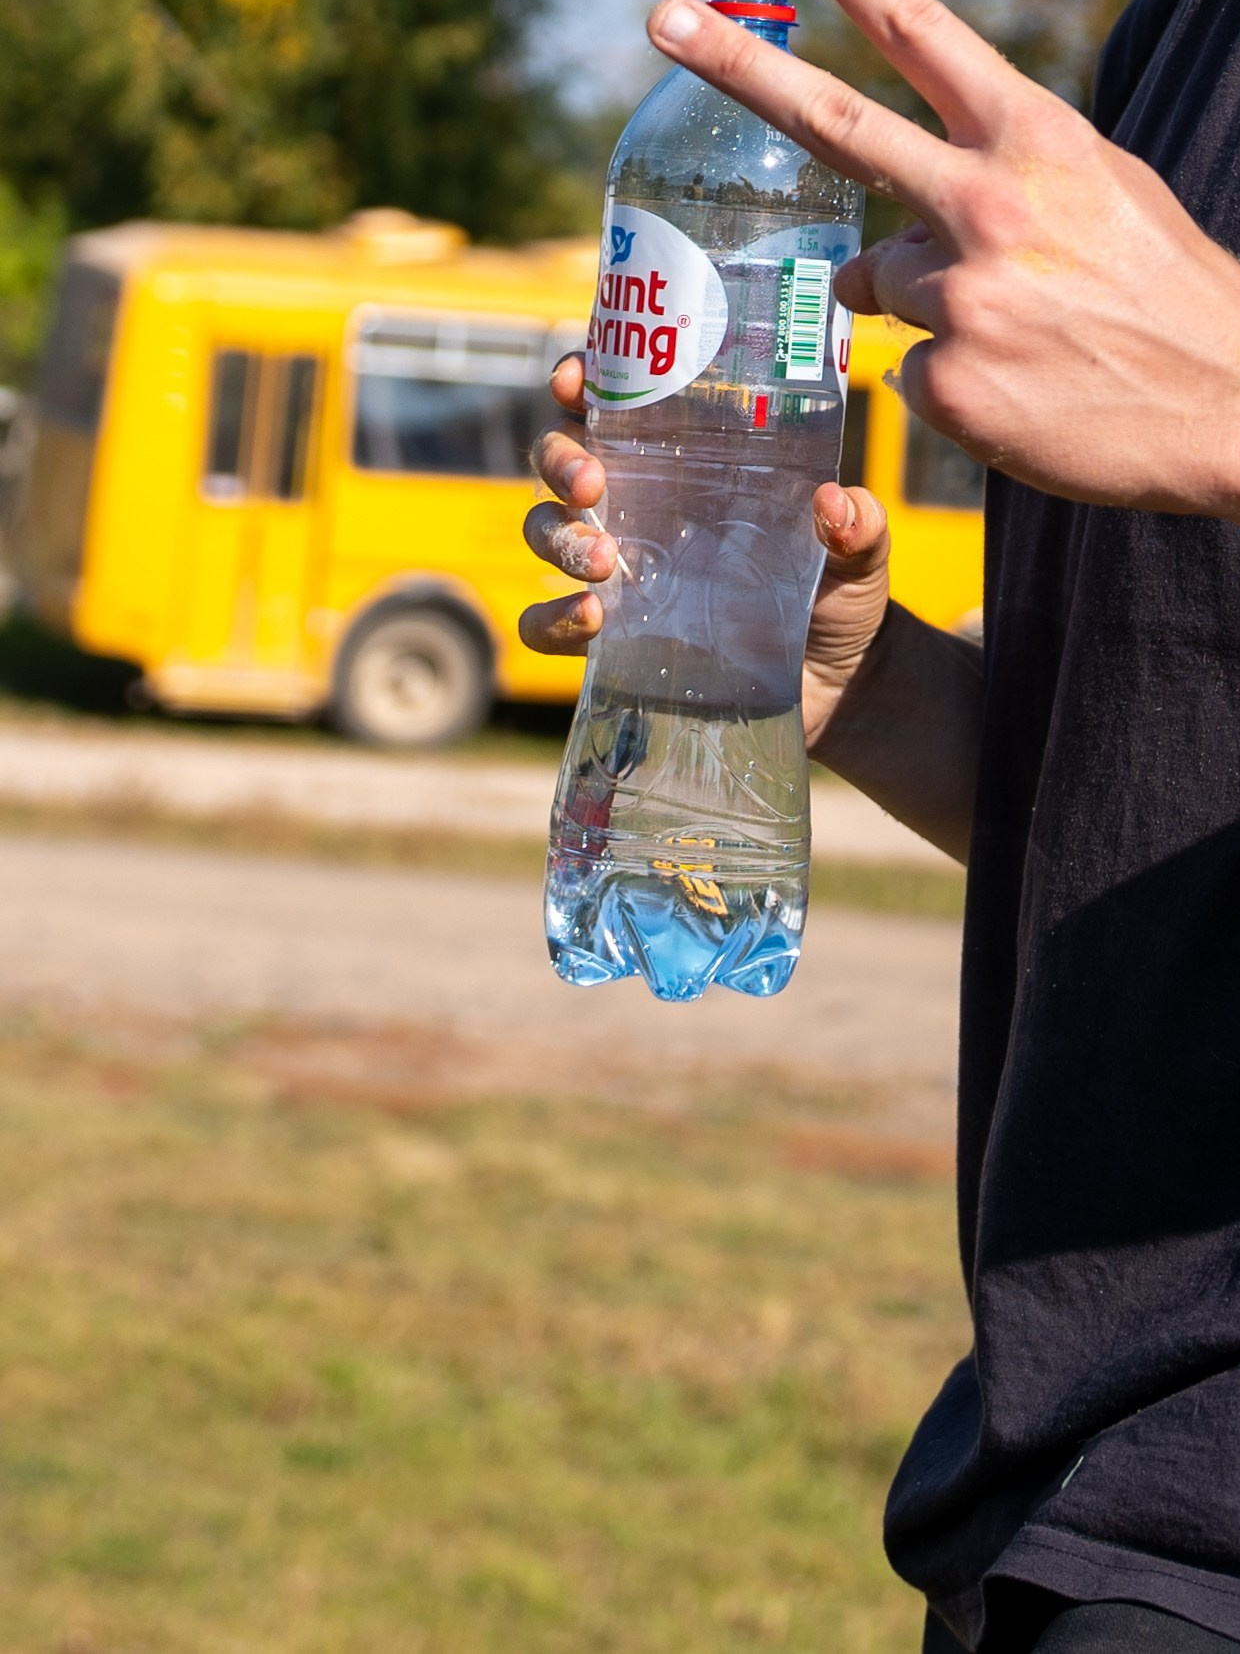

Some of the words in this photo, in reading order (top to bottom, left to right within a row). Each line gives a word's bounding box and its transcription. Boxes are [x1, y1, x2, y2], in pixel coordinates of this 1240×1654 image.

[798, 237, 818, 252] 1,5л
[781, 274, 790, 286] 14
[601, 270, 668, 316] aint
[780, 287, 788, 299] 13
[821, 270, 829, 314] 000748
[778, 301, 787, 317] 100
[777, 319, 786, 336] 800
[600, 368, 629, 381] PARKLING
